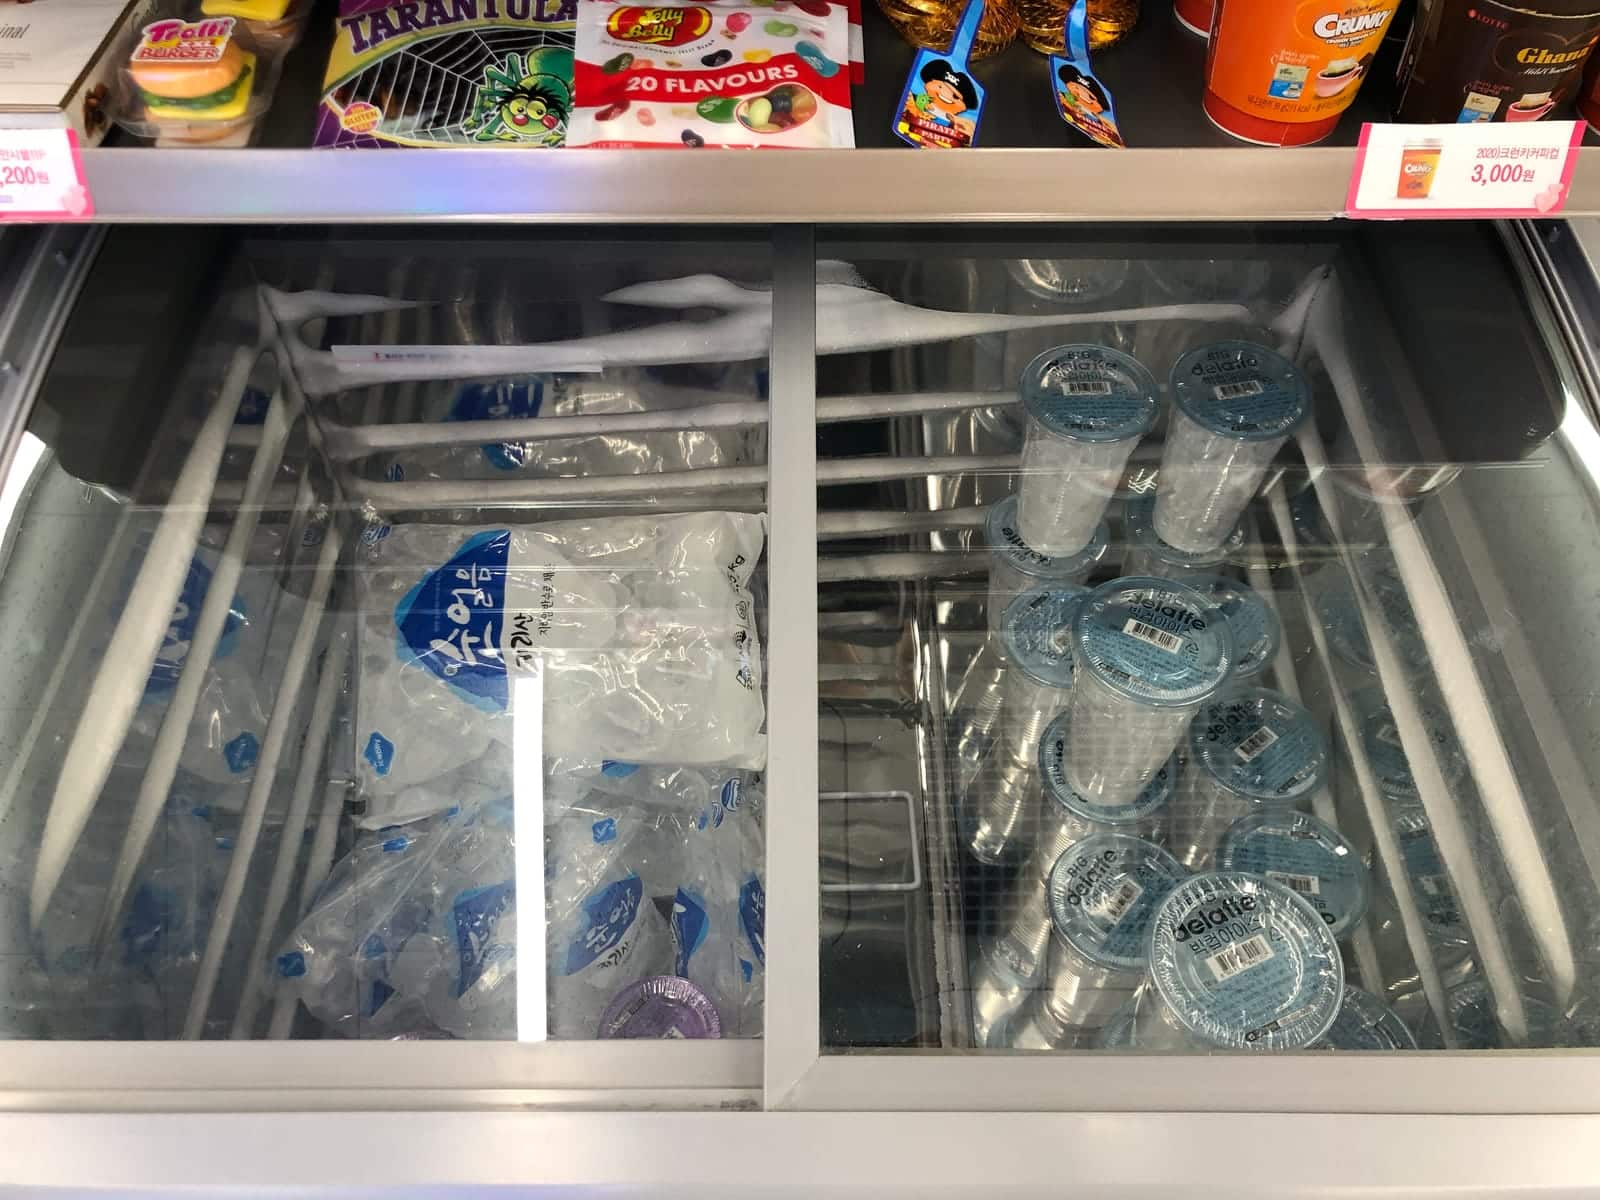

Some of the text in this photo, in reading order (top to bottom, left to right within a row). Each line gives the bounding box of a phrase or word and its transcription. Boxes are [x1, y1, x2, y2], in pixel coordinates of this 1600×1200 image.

[638, 7, 685, 26] Jelly
[147, 19, 229, 42] Trolli
[626, 64, 799, 94] 20 FLAVOURS
[1471, 163, 1536, 187] 3,000원
[1067, 856, 1089, 877] BIG
